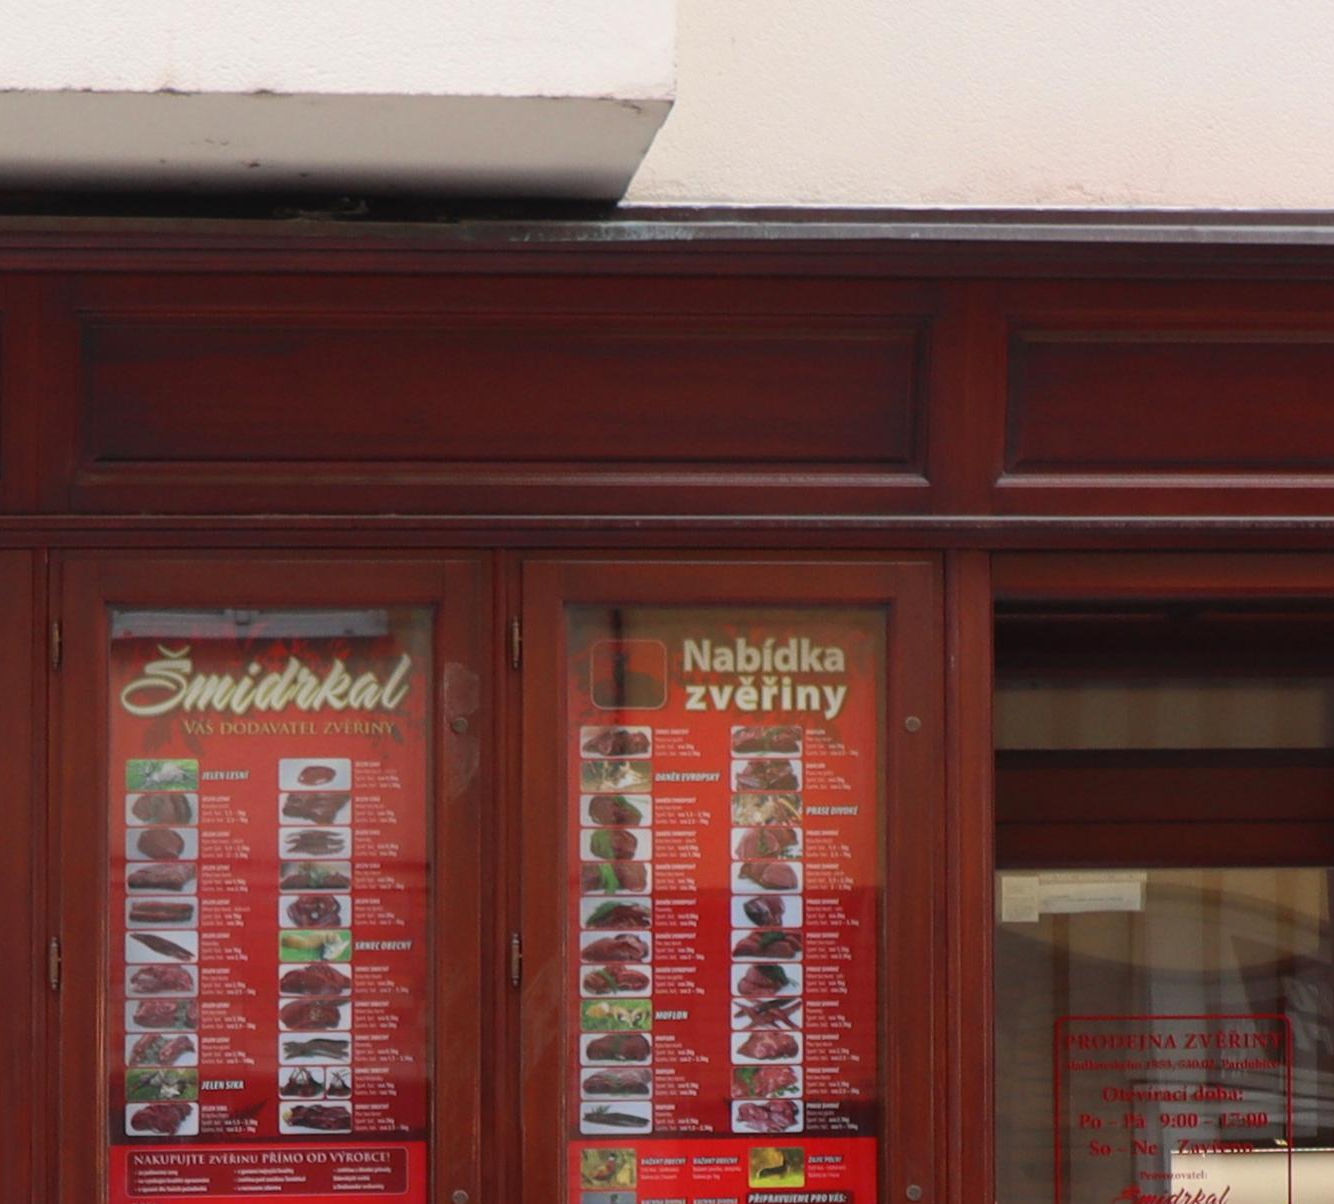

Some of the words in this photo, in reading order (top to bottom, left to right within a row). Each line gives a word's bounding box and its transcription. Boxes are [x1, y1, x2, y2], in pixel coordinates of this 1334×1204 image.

[683, 637, 846, 673] Nabídka
[120, 644, 412, 716] Šmidrkal
[685, 675, 848, 719] zvěřiny
[220, 721, 315, 736] DODAVATEL
[1066, 1033, 1177, 1052] PRODEJNA
[1185, 1029, 1283, 1050] ZVĚŘINY
[1102, 1085, 1188, 1103] Otevírací
[1193, 1084, 1244, 1102] doba:
[1079, 1113, 1102, 1129] Po
[1124, 1112, 1146, 1129] Pá
[1159, 1112, 1198, 1129] 9:00
[1219, 1111, 1268, 1128] 17:00
[1090, 1140, 1111, 1157] So
[1130, 1140, 1158, 1156] Ne
[133, 1154, 206, 1167] NAKUPUJTE
[261, 1151, 304, 1165] PŘÍMO
[306, 1152, 328, 1164] OD
[810, 1193, 828, 1203] PRO
